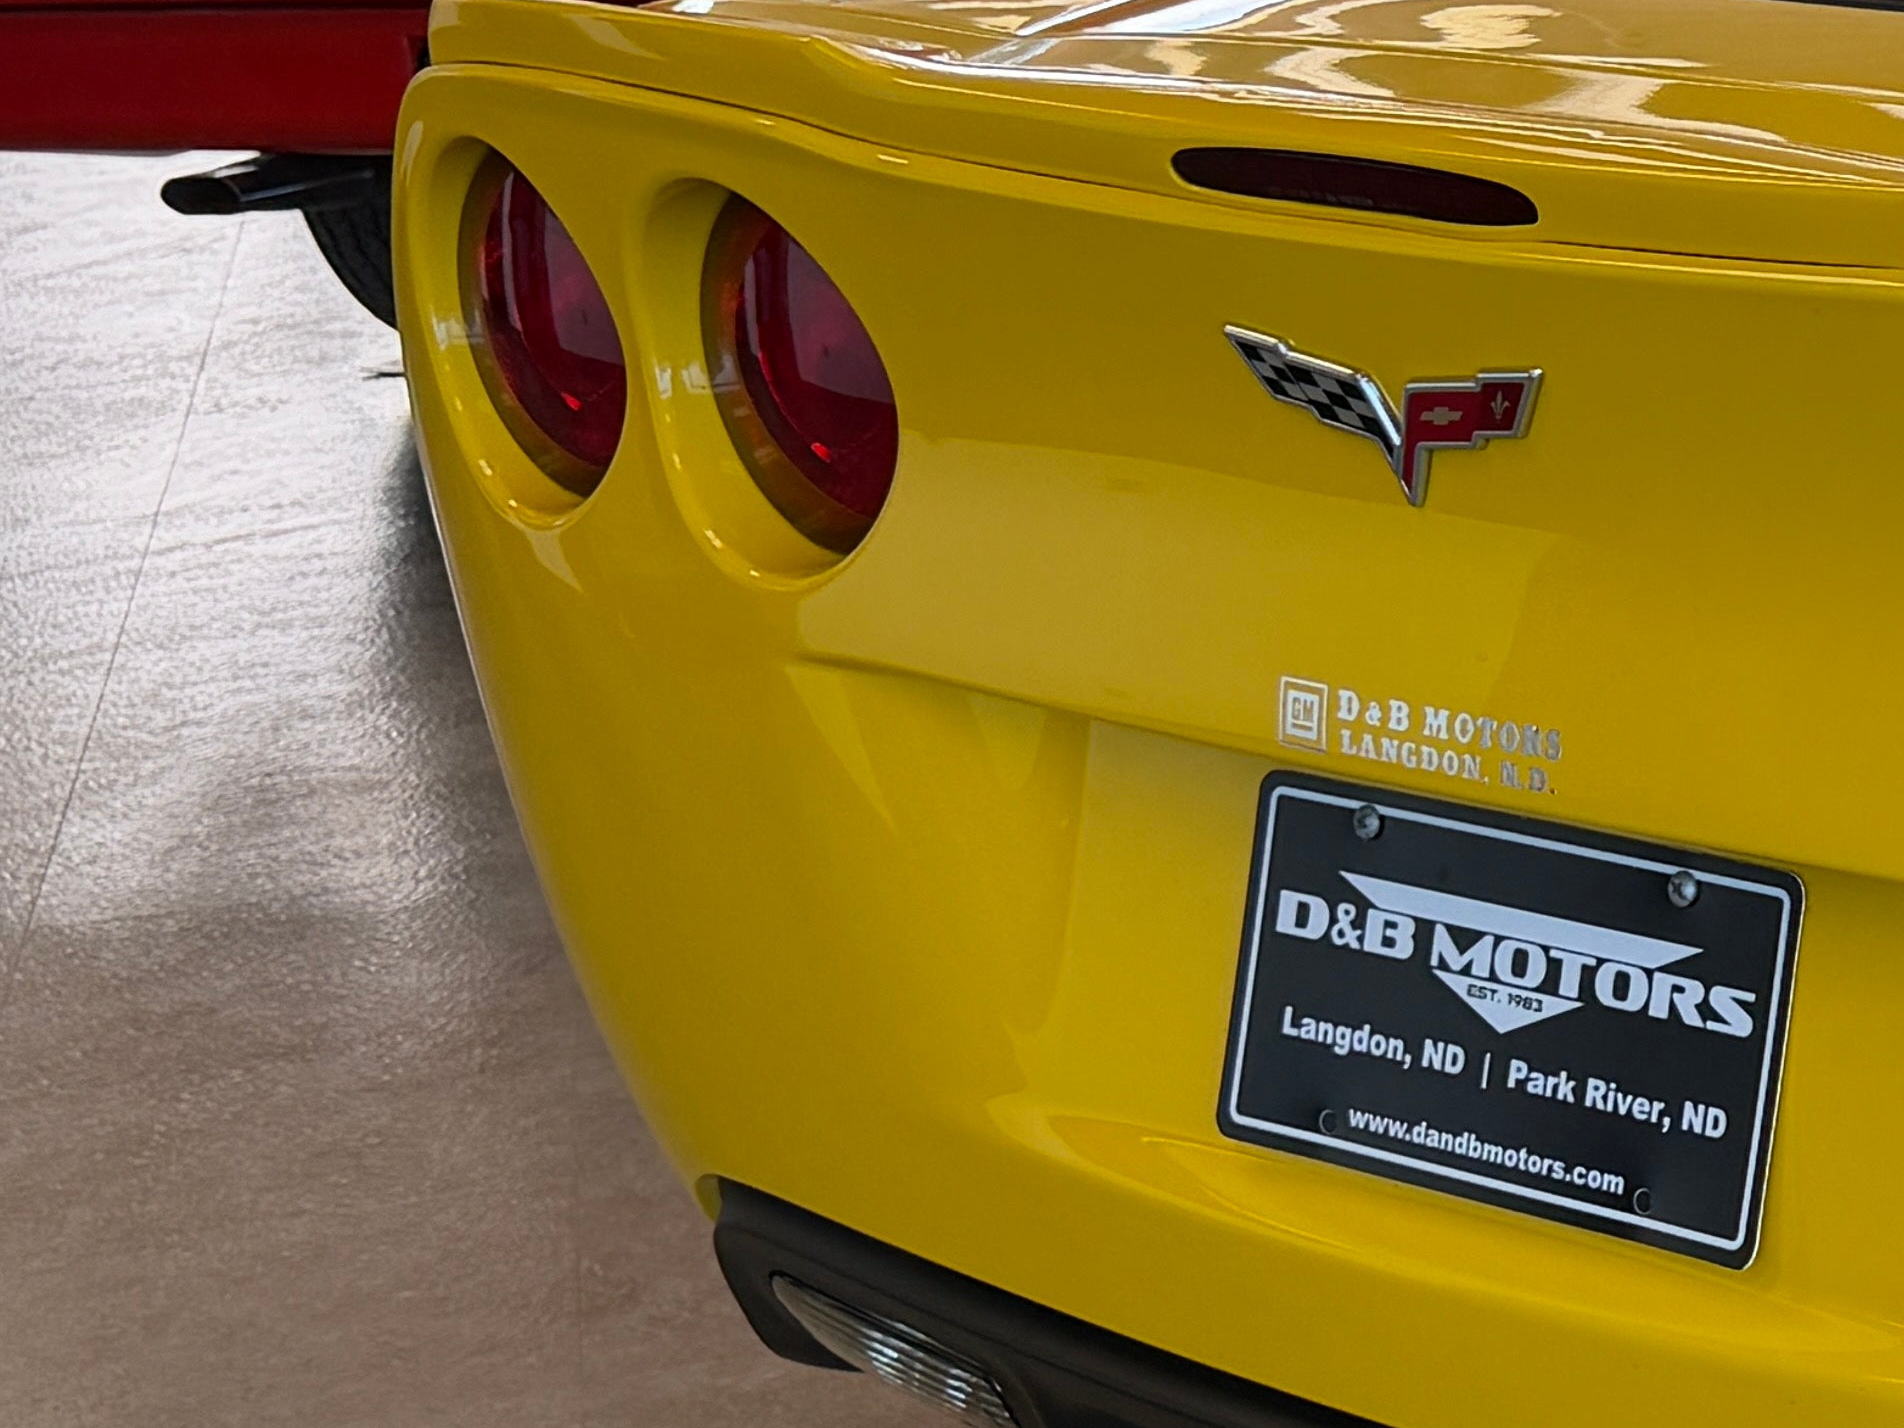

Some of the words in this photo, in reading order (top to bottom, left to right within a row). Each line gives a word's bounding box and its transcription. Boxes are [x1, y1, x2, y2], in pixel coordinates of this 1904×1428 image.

[1291, 695, 1315, 722] GM
[1336, 688, 1411, 732] D&B
[1422, 705, 1562, 762] MOTORS
[1340, 729, 1489, 785] LANGDON,
[1500, 760, 1557, 795] N.D.
[1274, 888, 1417, 960] D&B
[1429, 922, 1757, 1039] MOTORS
[1466, 983, 1502, 1004] EST.
[1506, 989, 1544, 1013] 1983
[1281, 1005, 1412, 1069] Langdon,
[1422, 1038, 1466, 1076] ND
[1506, 1058, 1576, 1105] Park
[1584, 1077, 1673, 1134] River,
[1681, 1100, 1729, 1140] ND
[1348, 1107, 1626, 1196] www.dandbmotors.com
